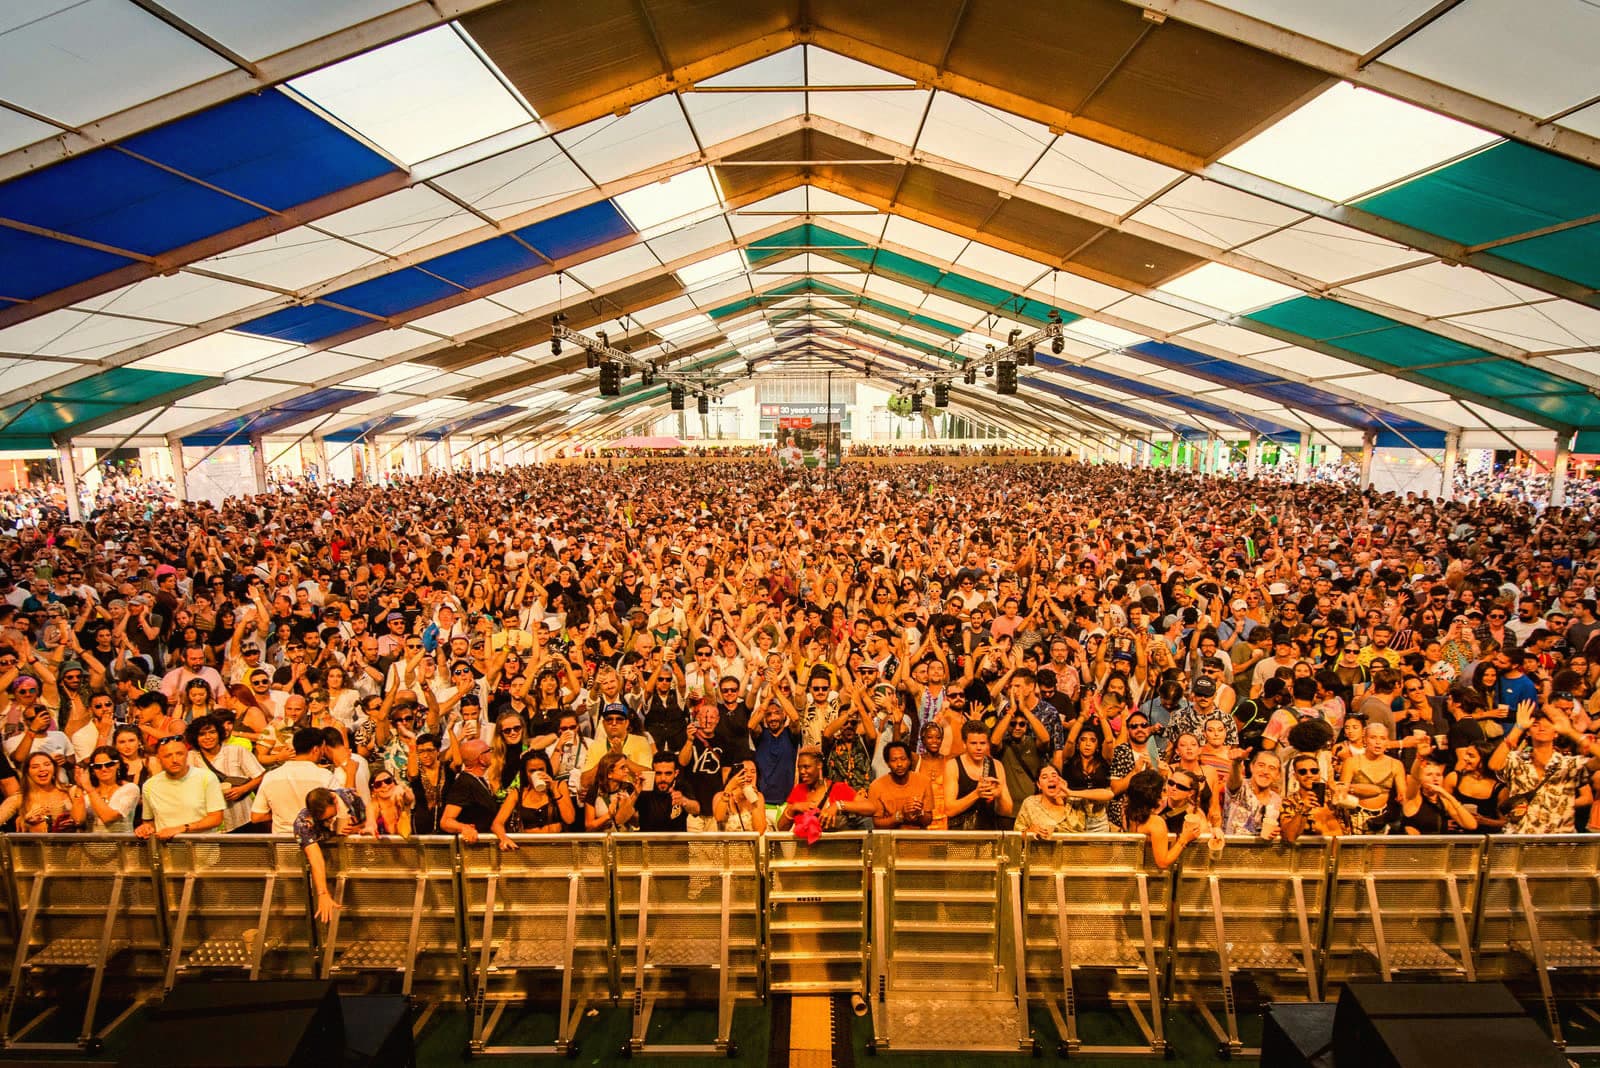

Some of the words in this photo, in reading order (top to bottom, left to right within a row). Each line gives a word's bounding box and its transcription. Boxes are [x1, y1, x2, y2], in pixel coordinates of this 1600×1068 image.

[780, 406, 790, 414] 30
[790, 407, 809, 415] years
[810, 406, 818, 414] of
[692, 745, 724, 774] YES
